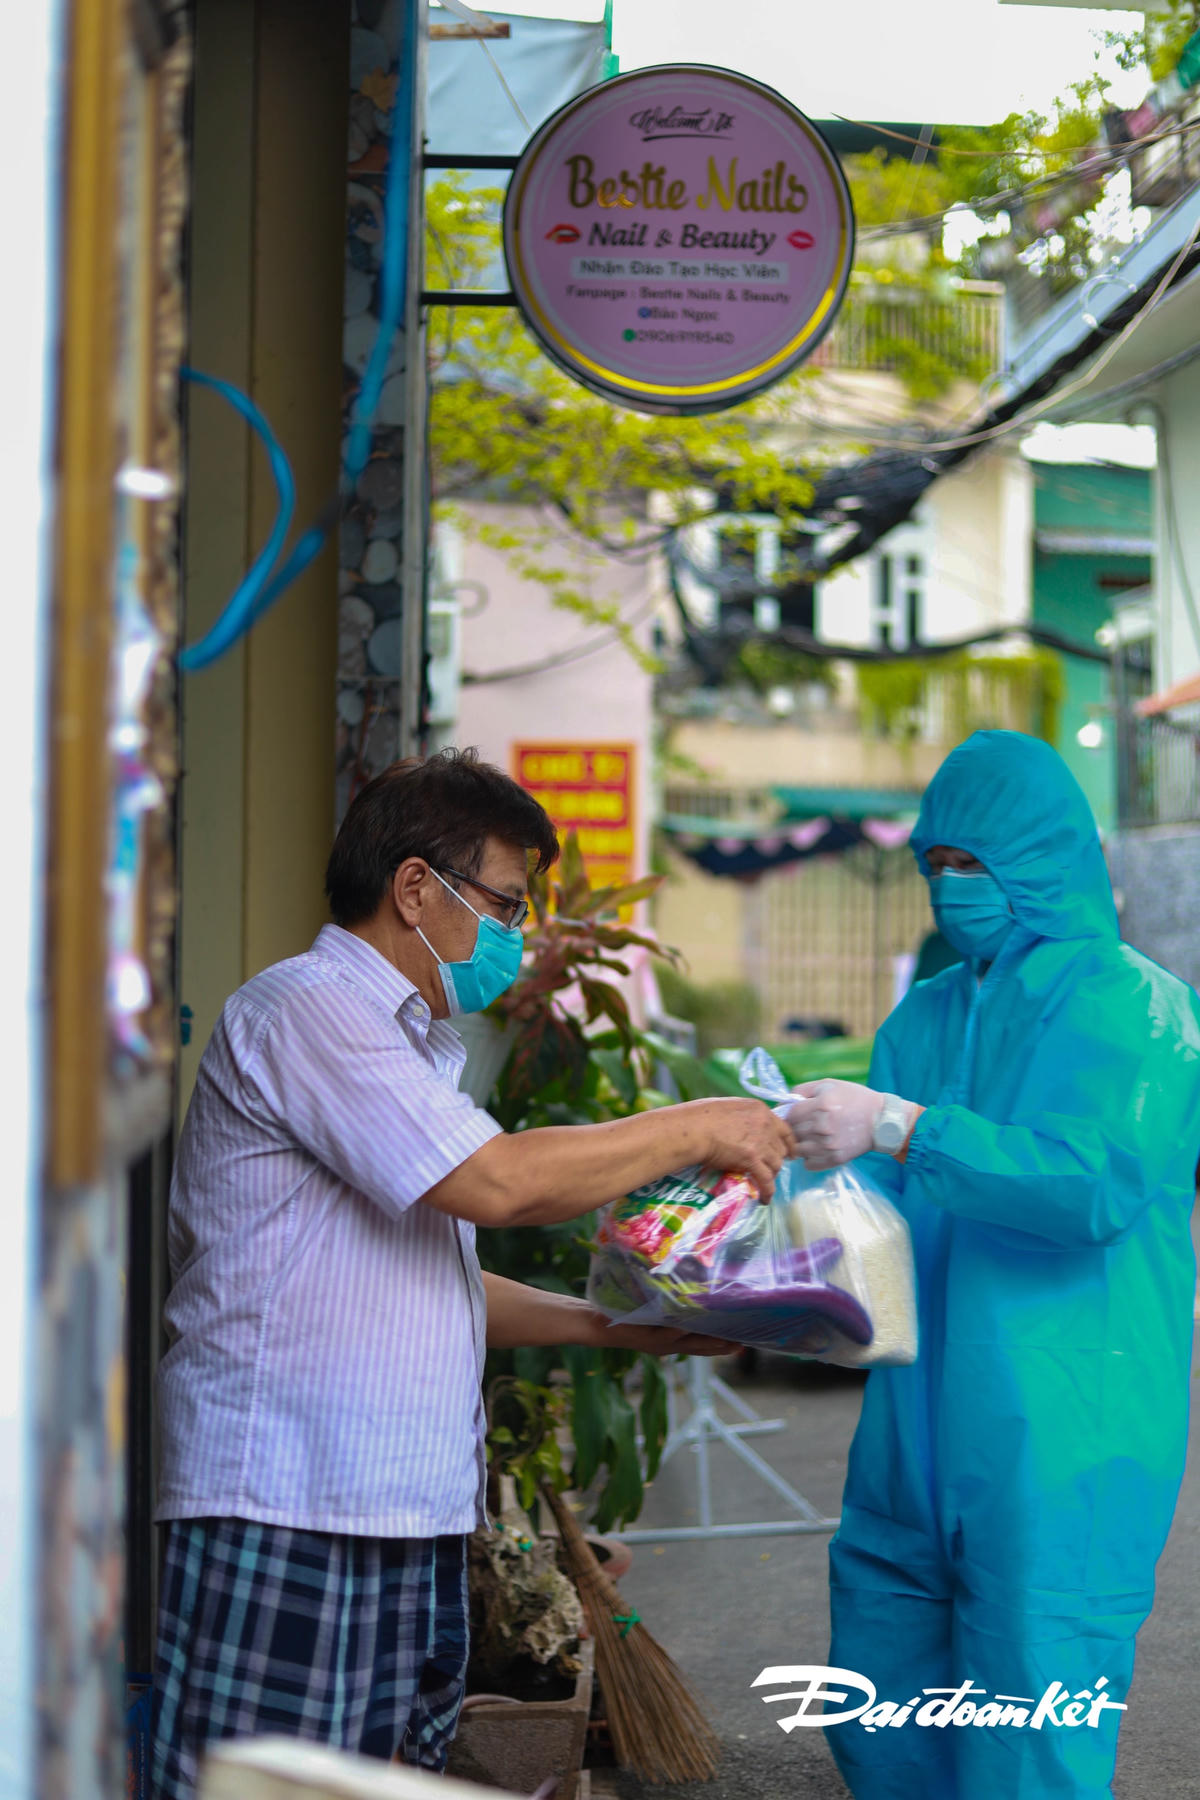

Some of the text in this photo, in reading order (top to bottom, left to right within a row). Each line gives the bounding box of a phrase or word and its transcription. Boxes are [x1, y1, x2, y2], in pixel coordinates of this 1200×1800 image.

[565, 154, 809, 213] Bestie Nails
[588, 223, 776, 256] Nail & Beauty
